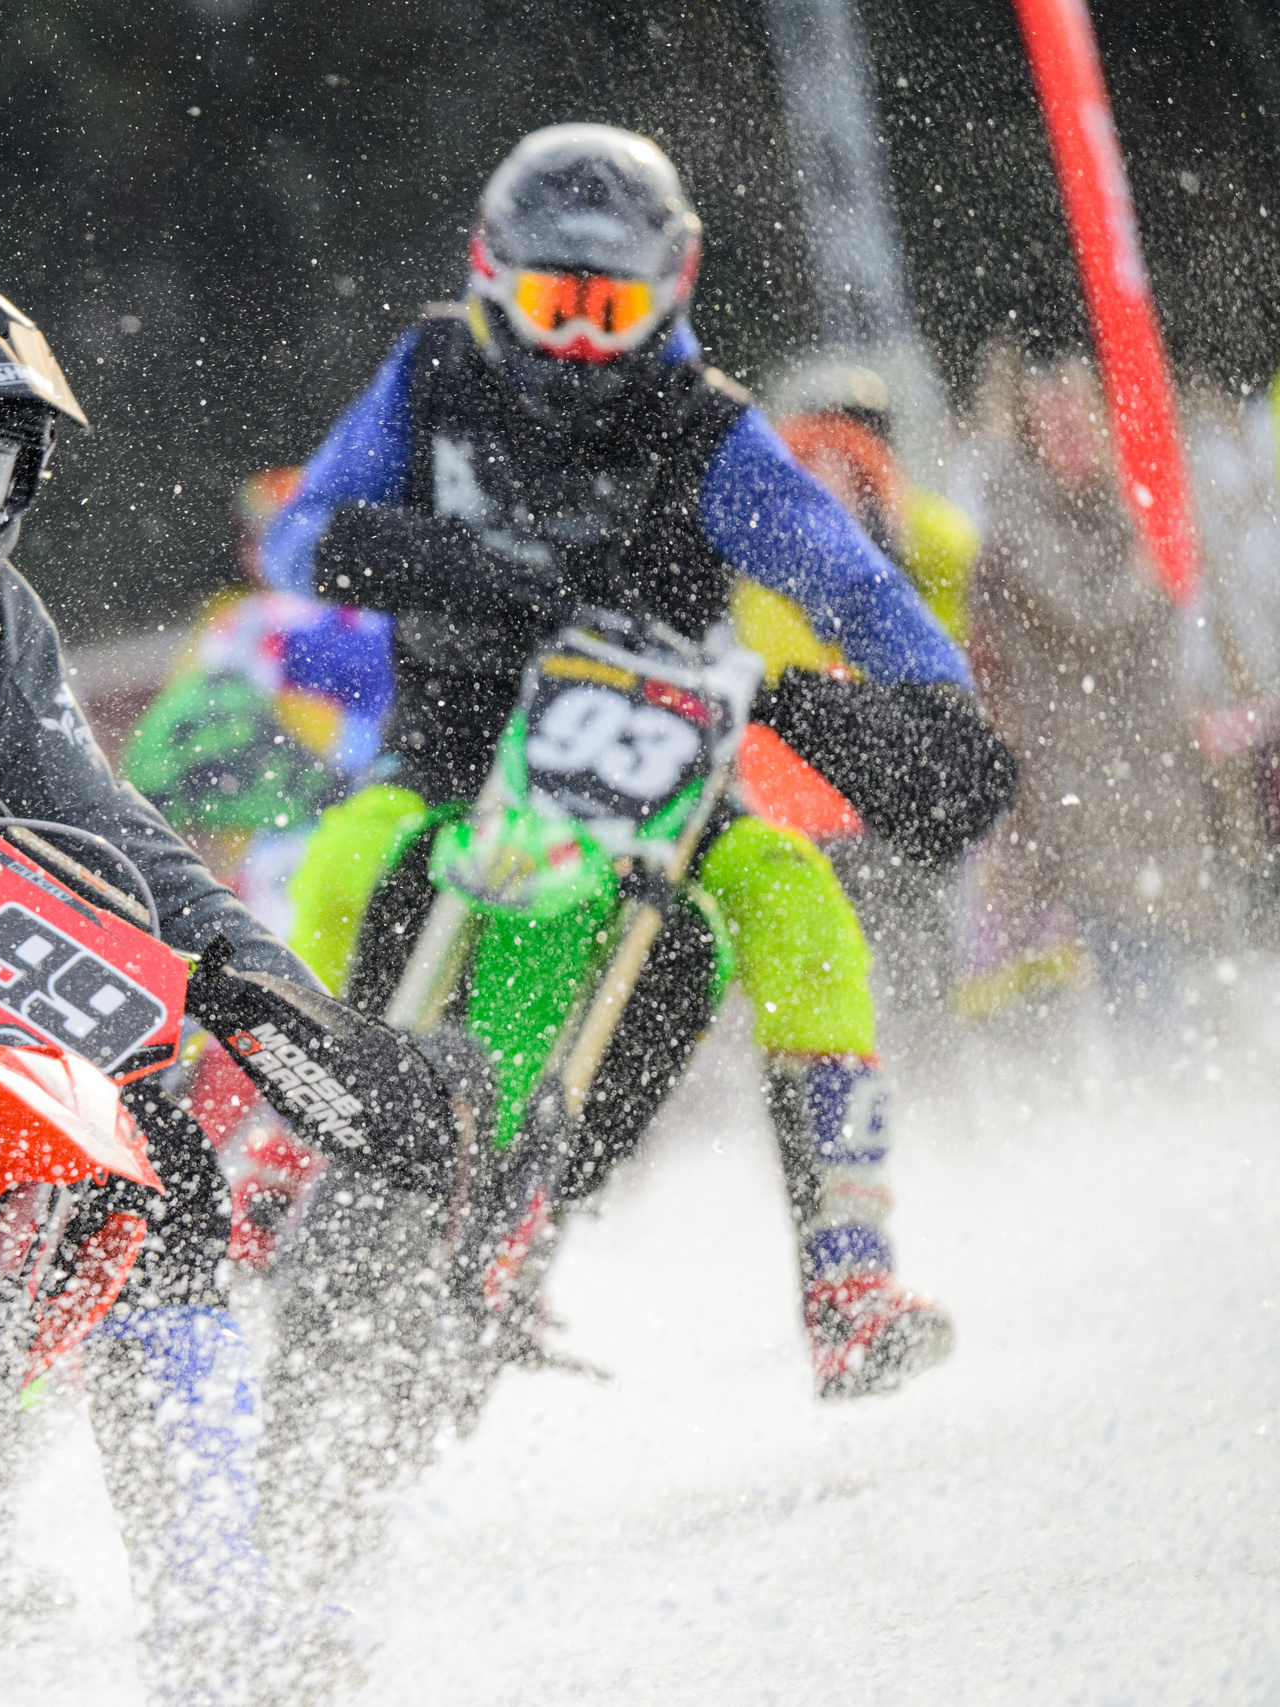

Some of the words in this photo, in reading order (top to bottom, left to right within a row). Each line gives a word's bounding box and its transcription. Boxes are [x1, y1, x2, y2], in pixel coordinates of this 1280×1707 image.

[526, 686, 700, 799] 93
[247, 1050, 367, 1148] RACING
[249, 1022, 365, 1117] MOOSE
